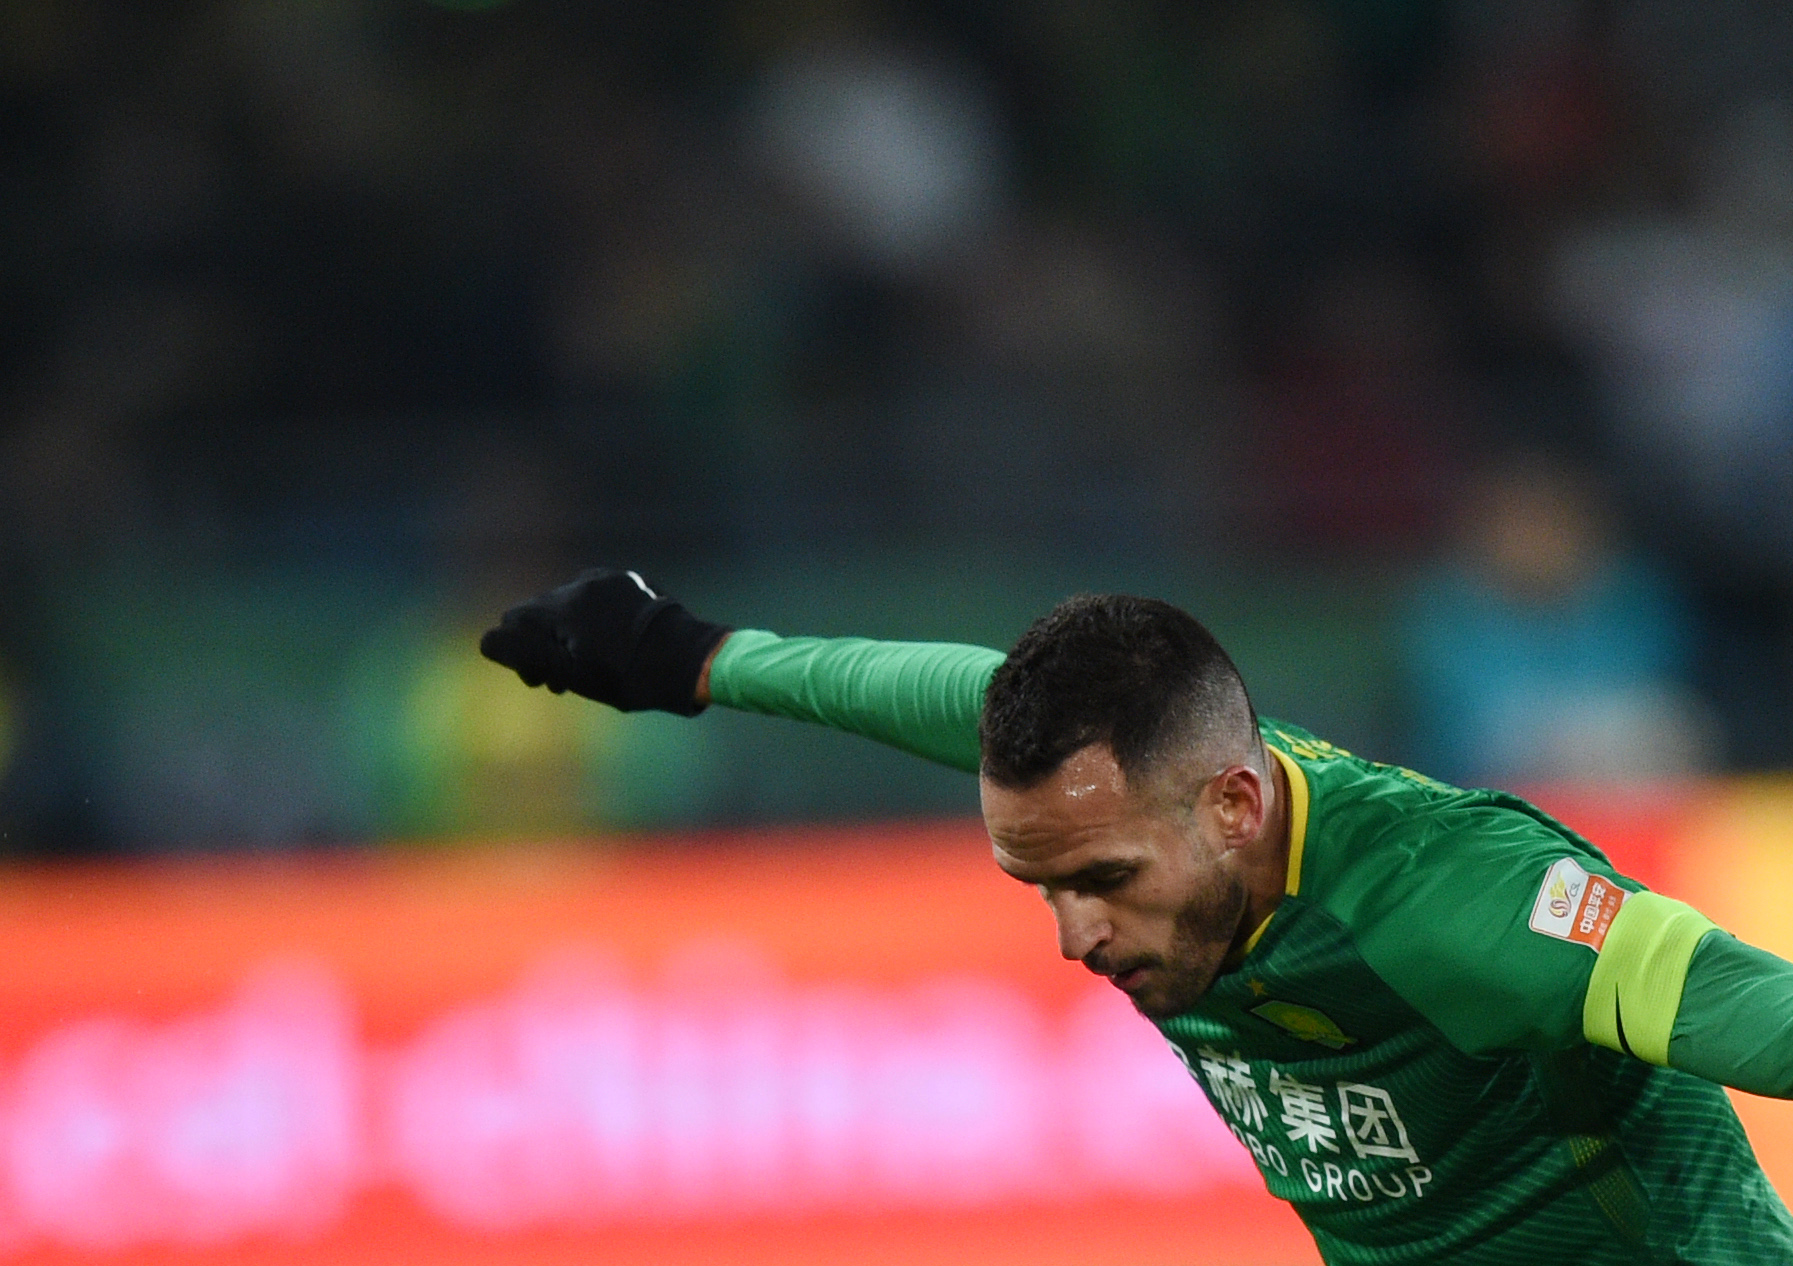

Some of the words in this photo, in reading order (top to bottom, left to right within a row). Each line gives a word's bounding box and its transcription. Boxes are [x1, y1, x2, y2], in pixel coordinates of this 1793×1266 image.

[1579, 882, 1607, 934] 中国平安
[1166, 1038, 1420, 1164] 赫集团
[1301, 1158, 1433, 1202] GROUP
